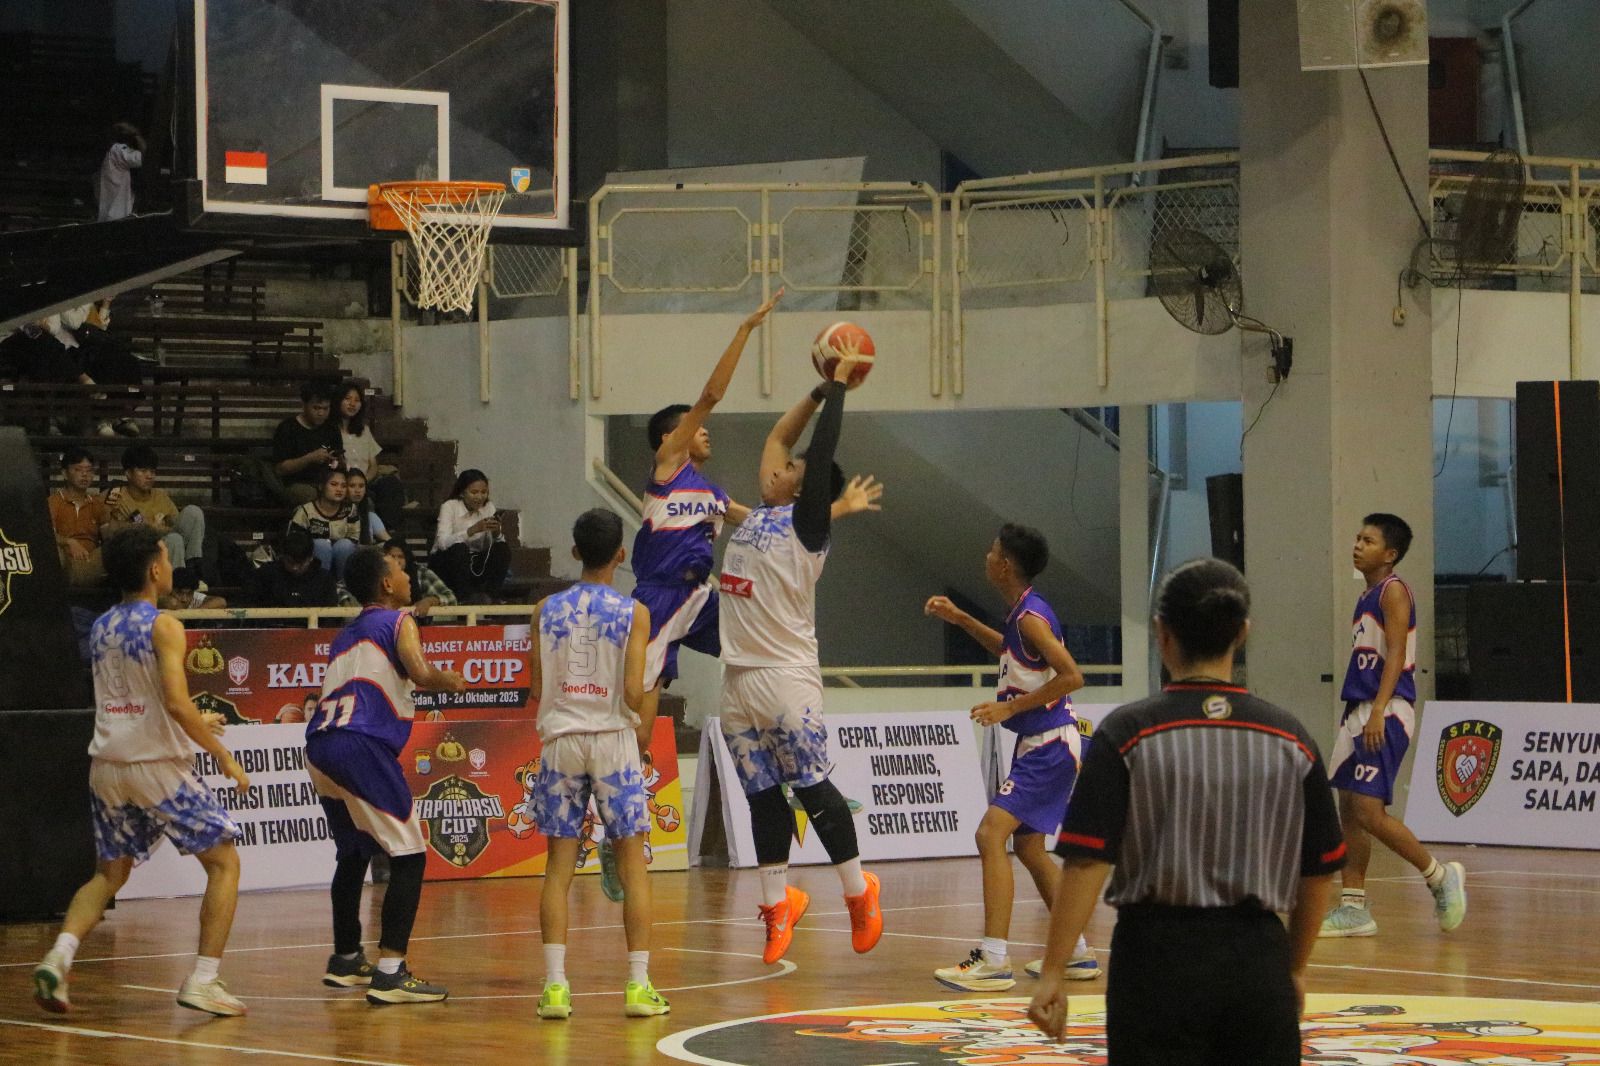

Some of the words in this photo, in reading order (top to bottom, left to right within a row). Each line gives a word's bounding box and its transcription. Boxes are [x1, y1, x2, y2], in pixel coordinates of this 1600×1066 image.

[315, 643, 330, 655] KE
[466, 640, 503, 652] ANTAR
[505, 640, 532, 652] PELA
[567, 626, 598, 677] 5
[463, 658, 523, 684] CUP
[1357, 653, 1379, 670] 07
[267, 663, 328, 688] KAP
[438, 693, 447, 705] 18
[465, 692, 498, 703] Oktober
[499, 691, 519, 702] 2025
[838, 726, 883, 750] CEPAT,
[884, 724, 960, 747] AKUNTABEL
[1450, 722, 1496, 738] SPKT
[193, 749, 270, 776] MENABDI
[273, 747, 307, 772] DEN
[870, 753, 941, 777] HUMANIS,
[1354, 764, 1379, 783] 07
[1511, 759, 1569, 786] SAPA,
[1576, 761, 1600, 783] DA
[213, 785, 264, 811] GRASI
[267, 782, 321, 808] MELAY
[871, 782, 945, 806] RESPONSIF
[1524, 788, 1596, 812] SALAM
[441, 817, 477, 834] CUP
[867, 812, 910, 836] SERTA
[911, 810, 959, 834] EFEKTIF
[450, 834, 469, 843] 2025
